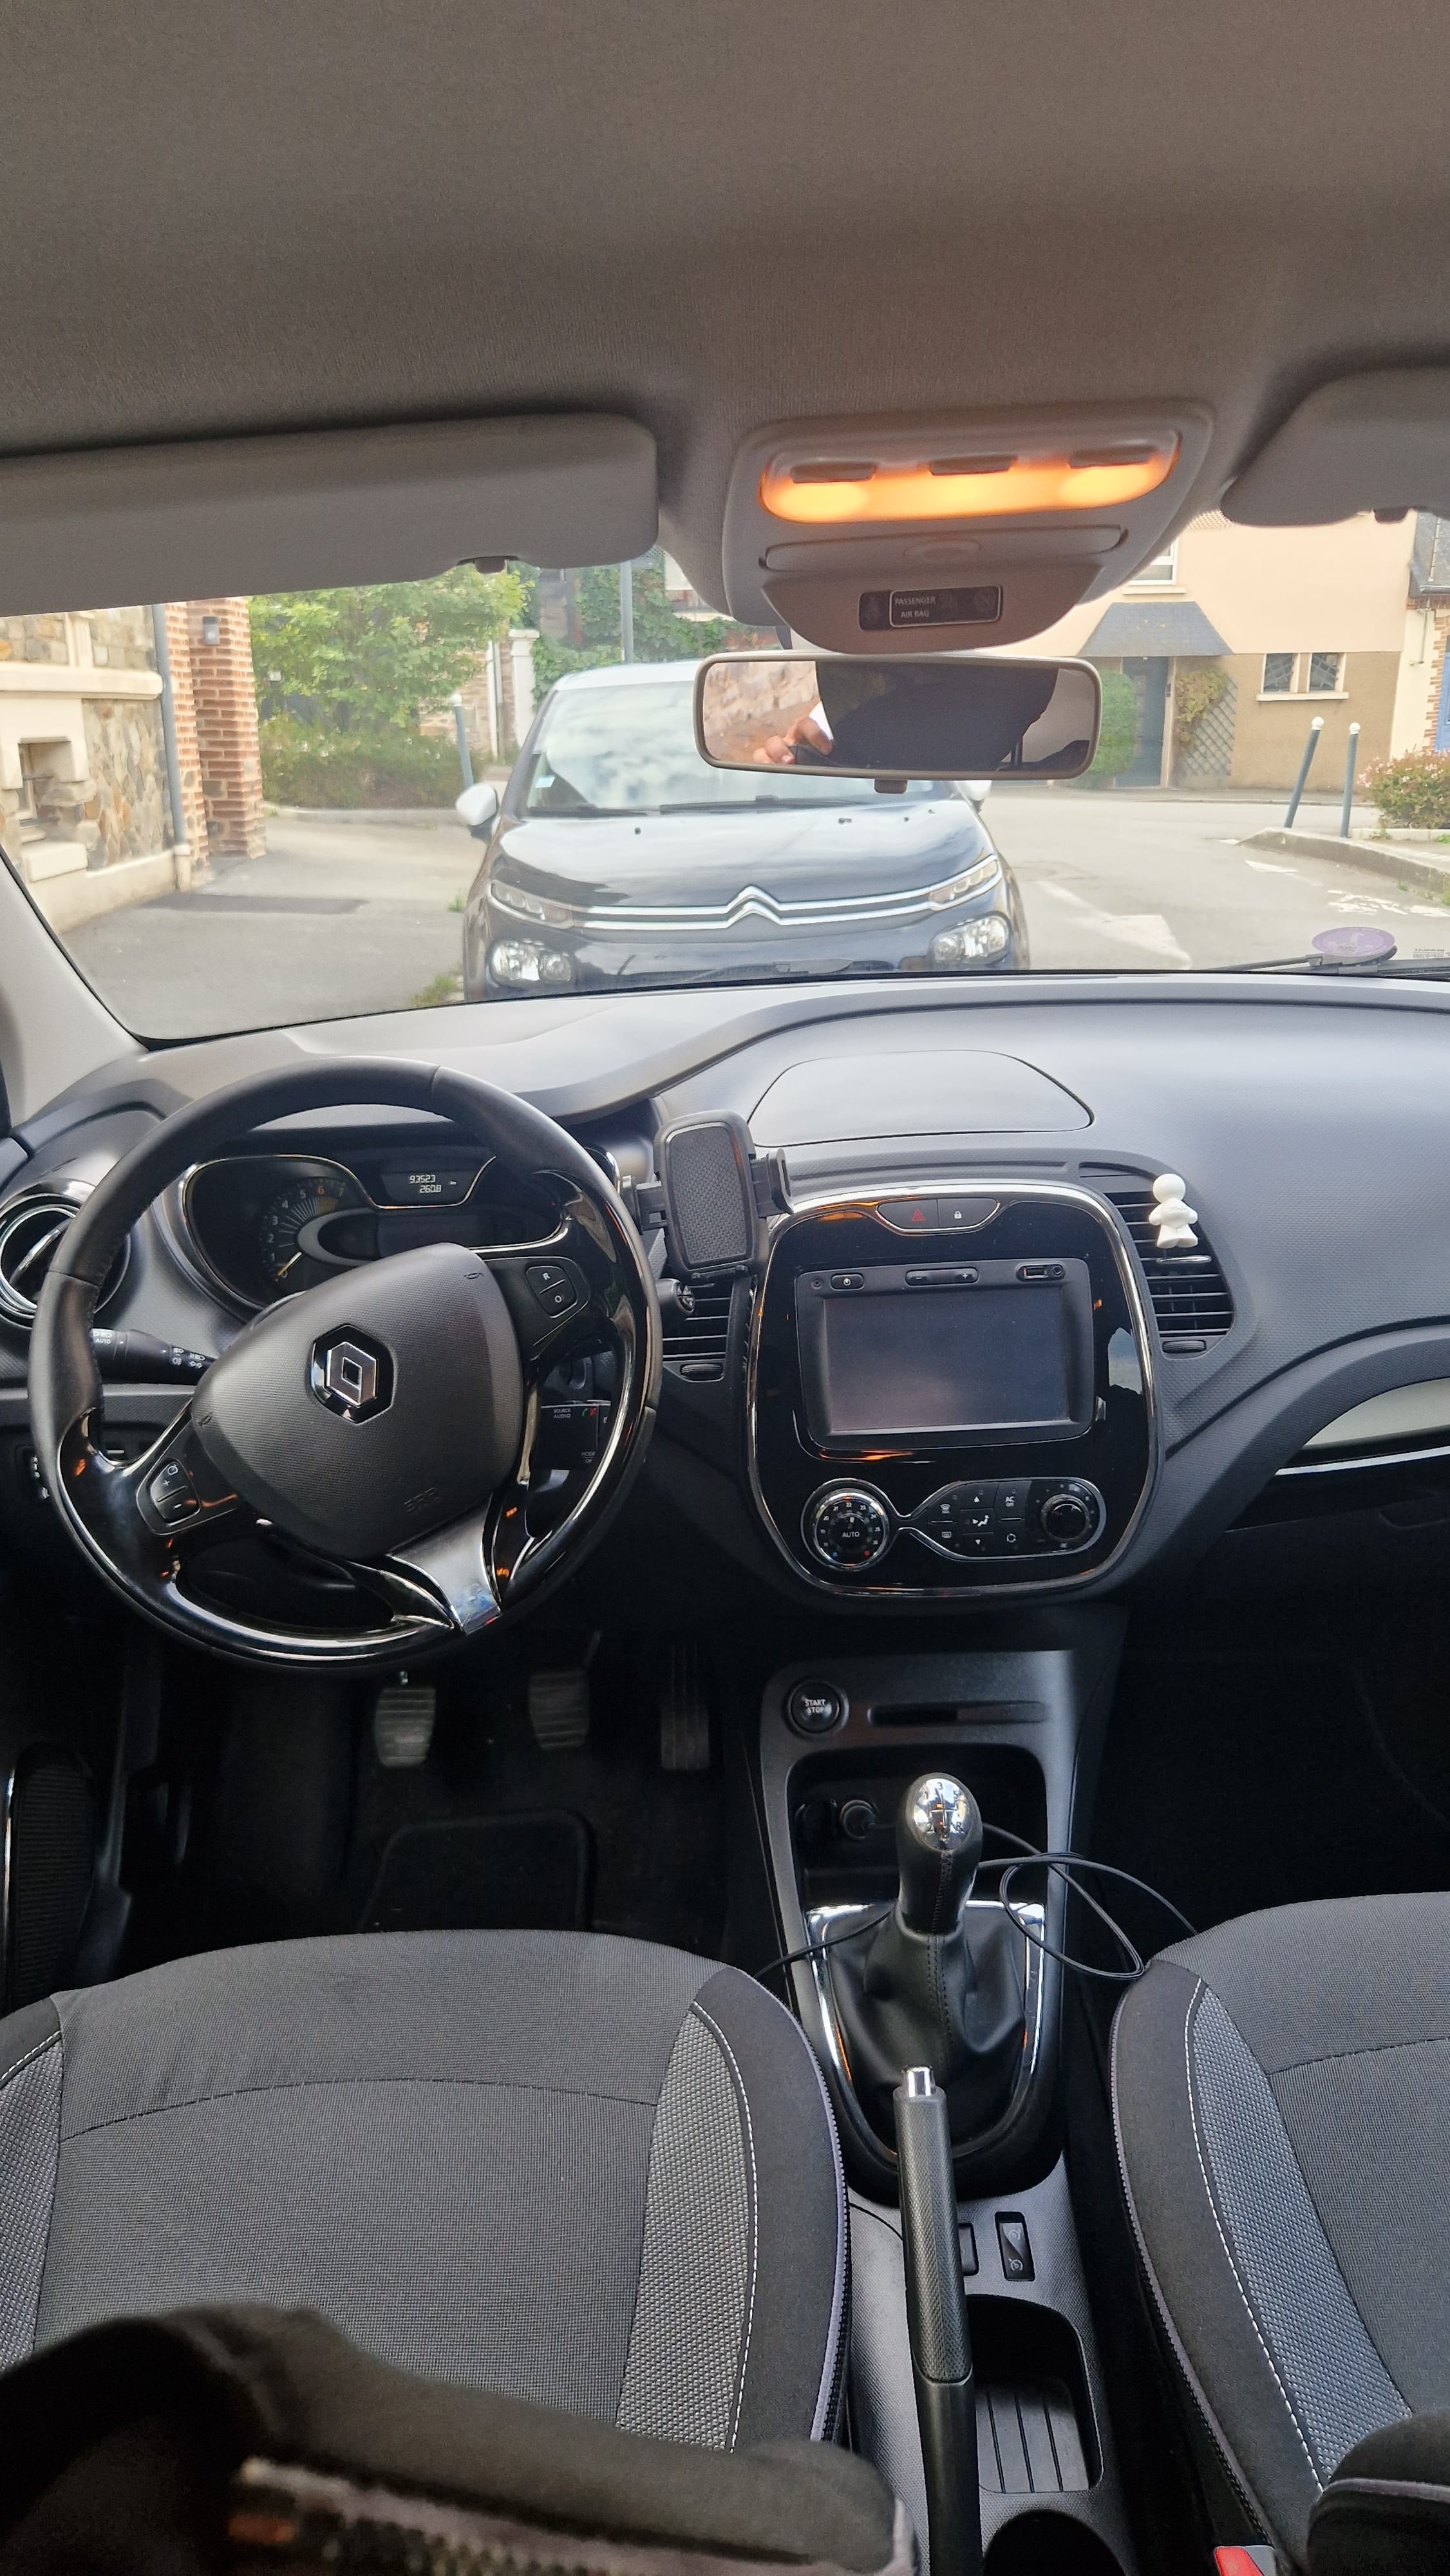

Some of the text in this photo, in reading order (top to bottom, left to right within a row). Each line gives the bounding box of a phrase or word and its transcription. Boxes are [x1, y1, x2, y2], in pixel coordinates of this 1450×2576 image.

[895, 596, 936, 605] PASSENGER
[410, 1175, 436, 1184] 93523
[300, 1190, 306, 1198] 5
[317, 1186, 325, 1195] 6
[339, 1188, 344, 1197] 7
[272, 1216, 278, 1225] 3
[268, 1234, 274, 1243] 2
[271, 1253, 275, 1261] 1
[925, 1791, 928, 1799] 1
[953, 1790, 959, 1799] 5
[927, 1822, 935, 1832] 2
[956, 1821, 965, 1832] R
